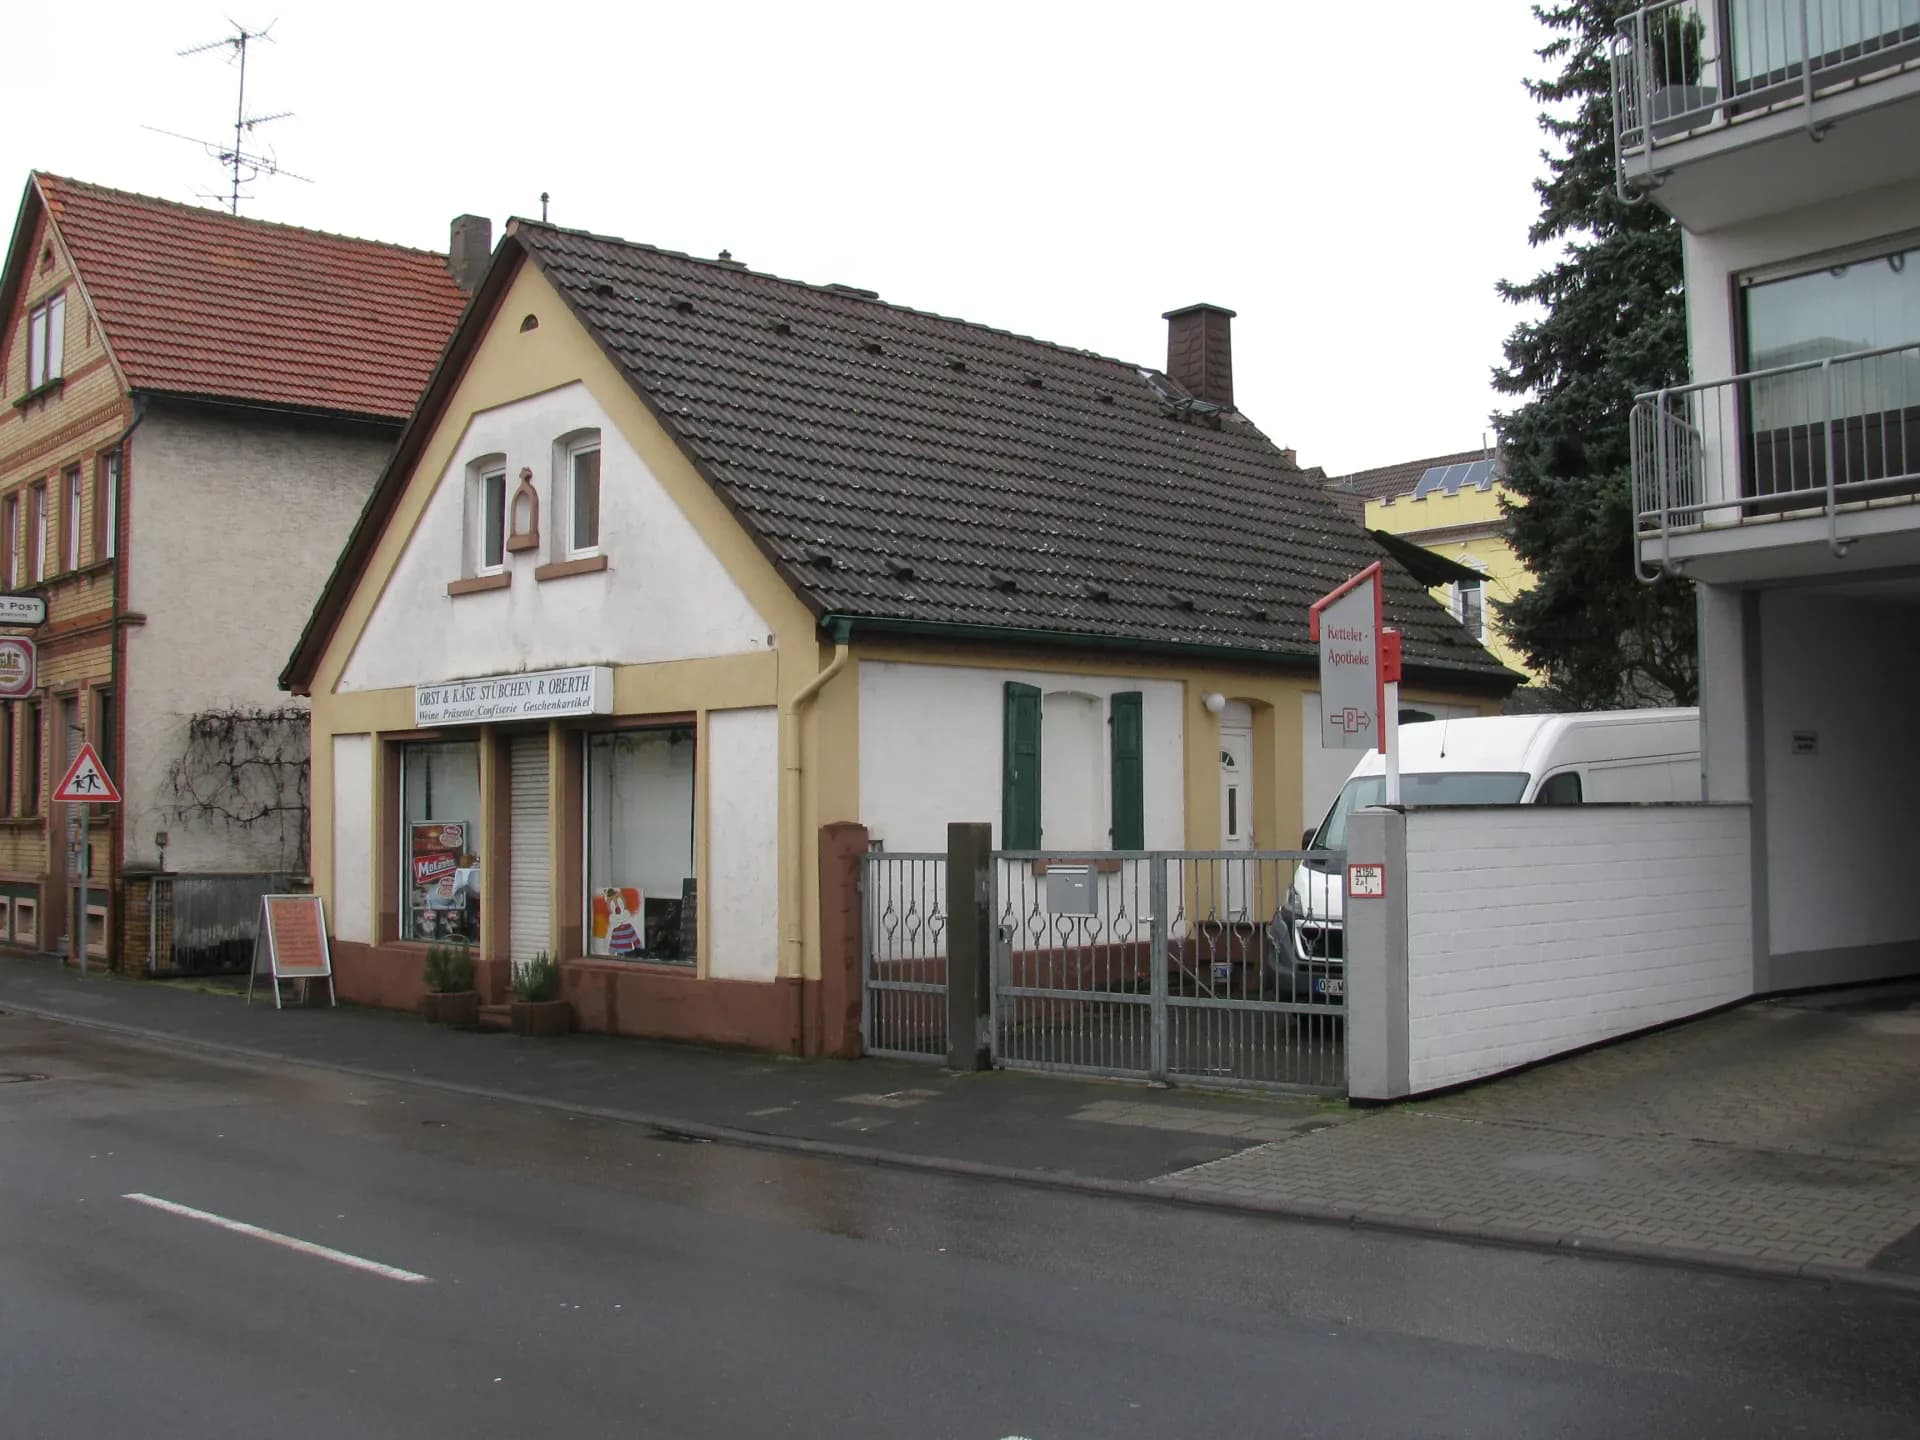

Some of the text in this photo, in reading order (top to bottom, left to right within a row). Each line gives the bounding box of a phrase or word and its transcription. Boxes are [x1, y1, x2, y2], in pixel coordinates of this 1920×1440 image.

[1327, 648, 1369, 667] Apotheke
[419, 691, 440, 706] OBST
[443, 689, 449, 704] &
[452, 684, 477, 702] KÄSE
[479, 680, 532, 700] STÜBCHEN
[548, 675, 590, 694] OBERTH
[419, 695, 591, 721] Weine Präsente Confiserie Geschenkartikel
[1346, 711, 1354, 729] P
